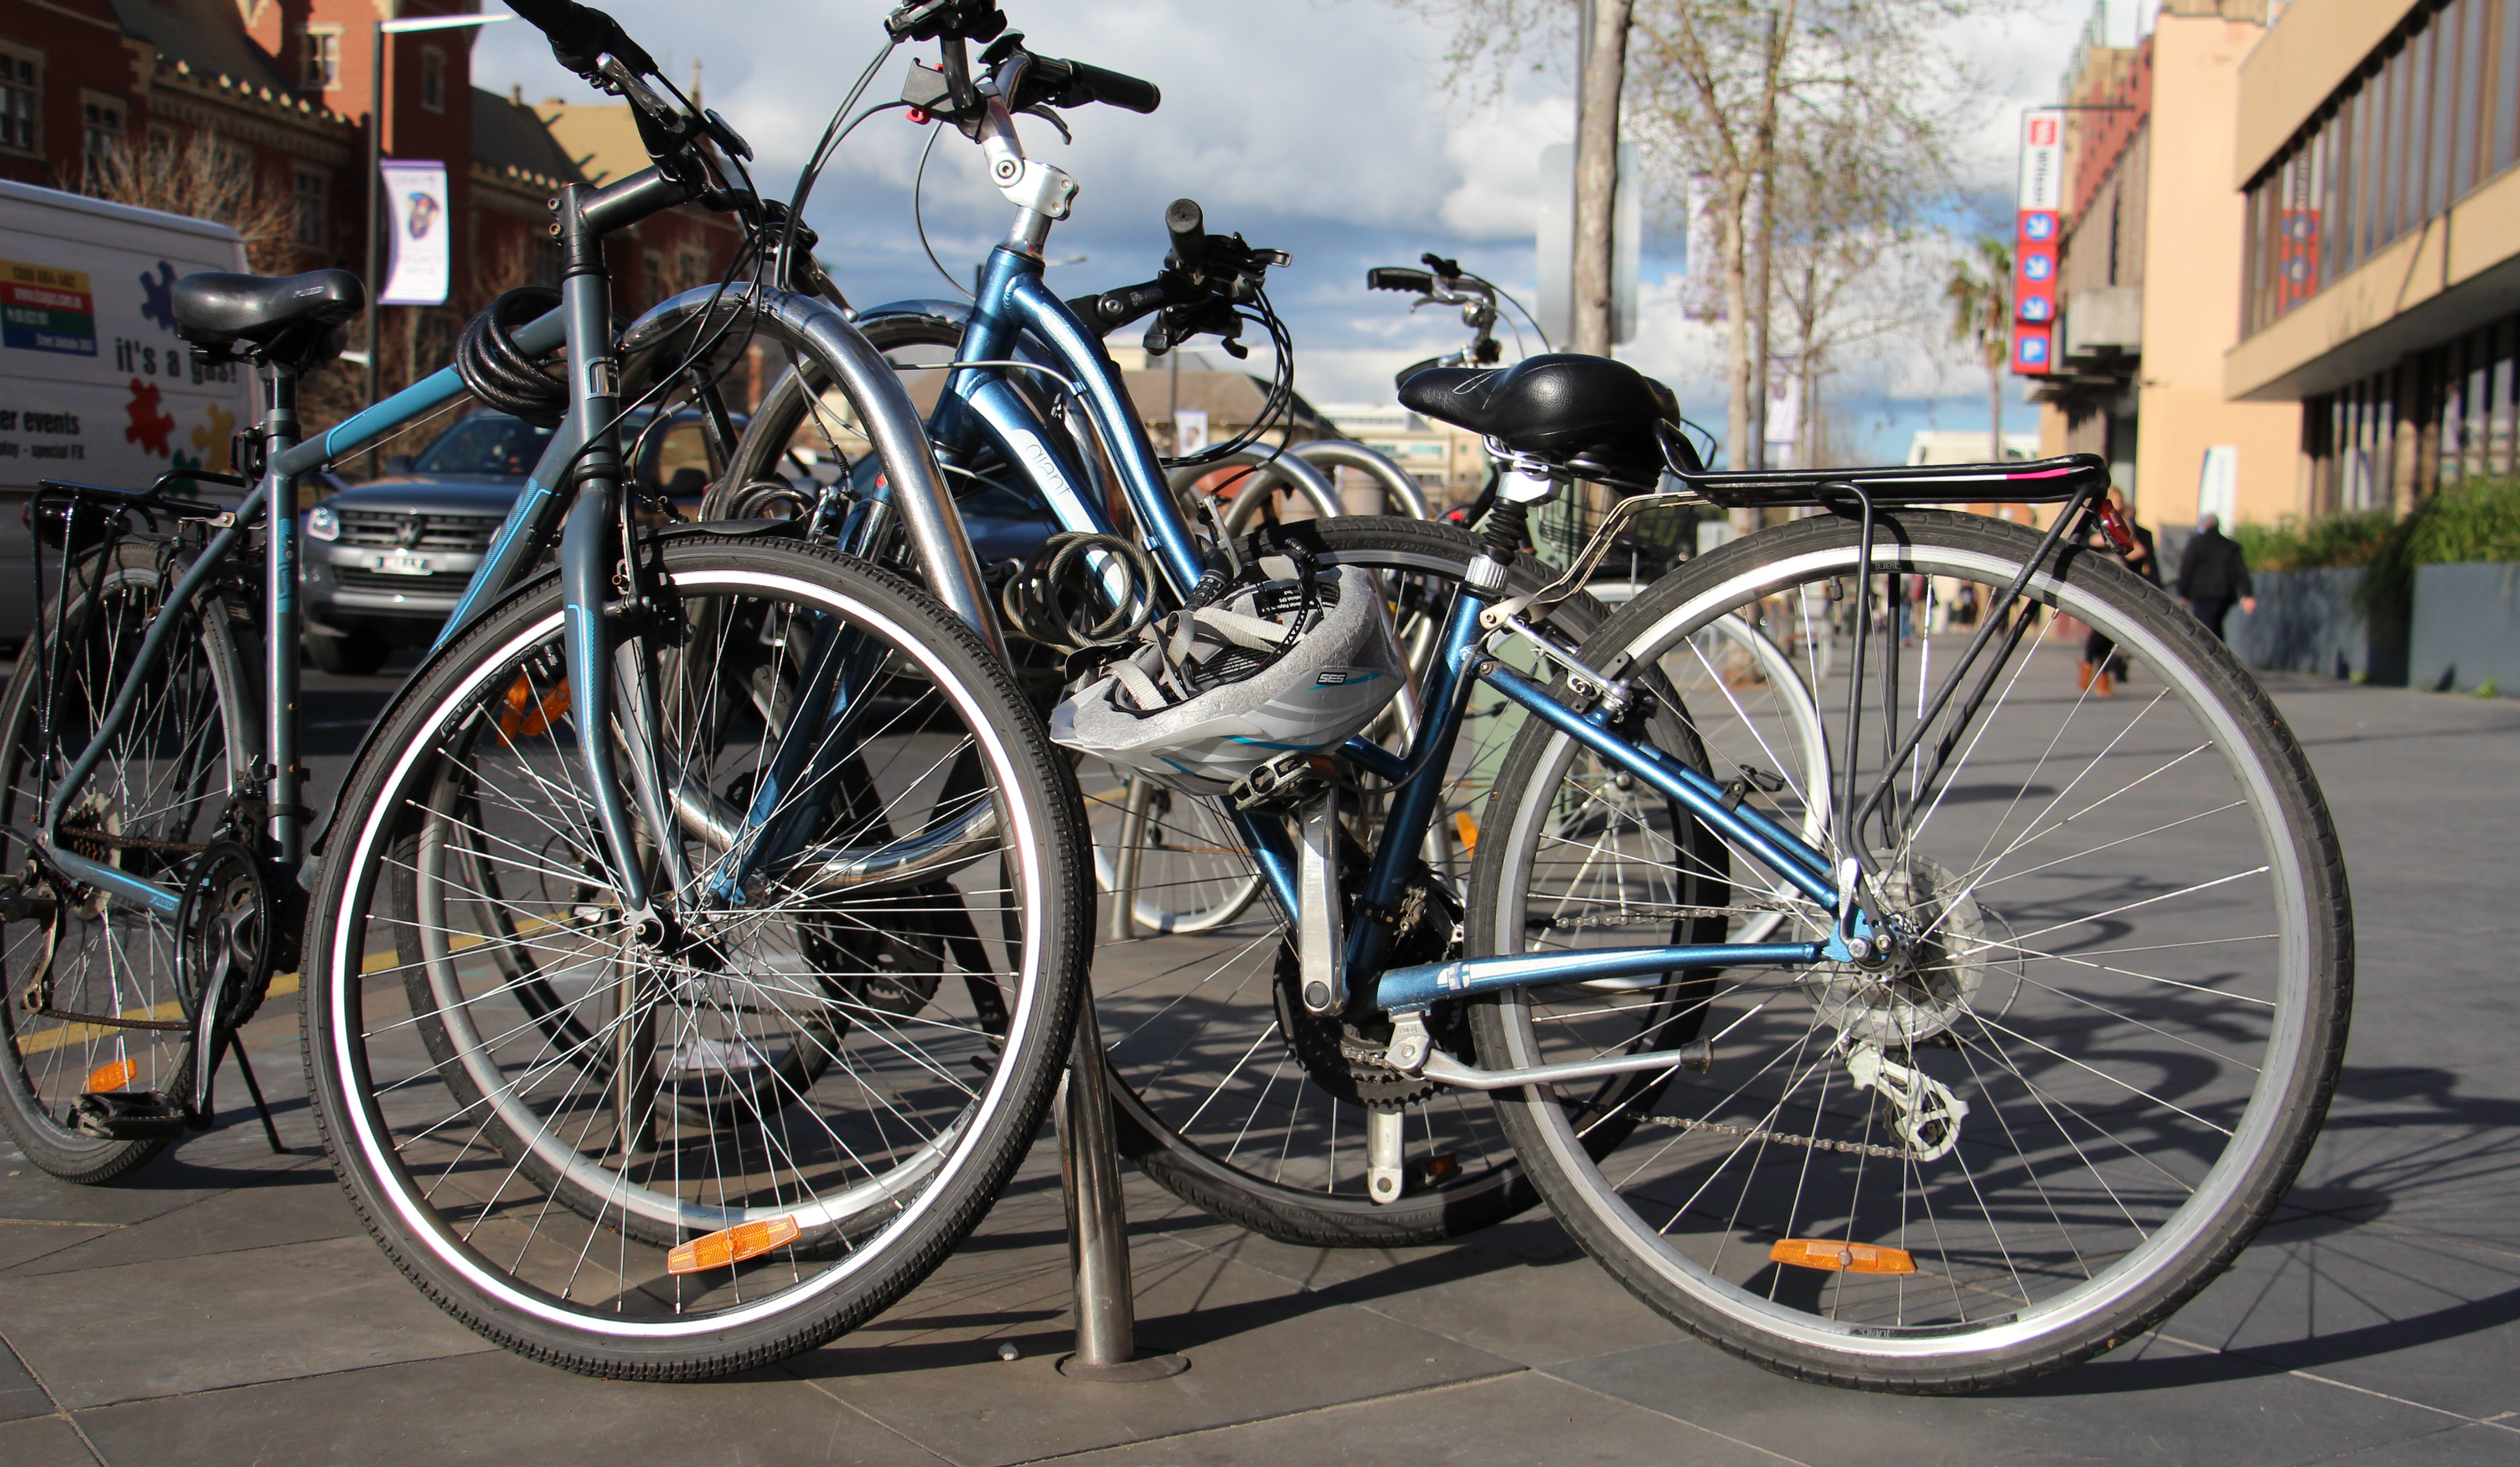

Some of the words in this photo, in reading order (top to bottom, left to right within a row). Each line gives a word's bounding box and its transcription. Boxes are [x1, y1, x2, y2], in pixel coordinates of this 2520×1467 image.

[116, 336, 156, 375] it's
[166, 349, 180, 377] a
[23, 411, 81, 436] events
[1317, 673, 1346, 684] SES
